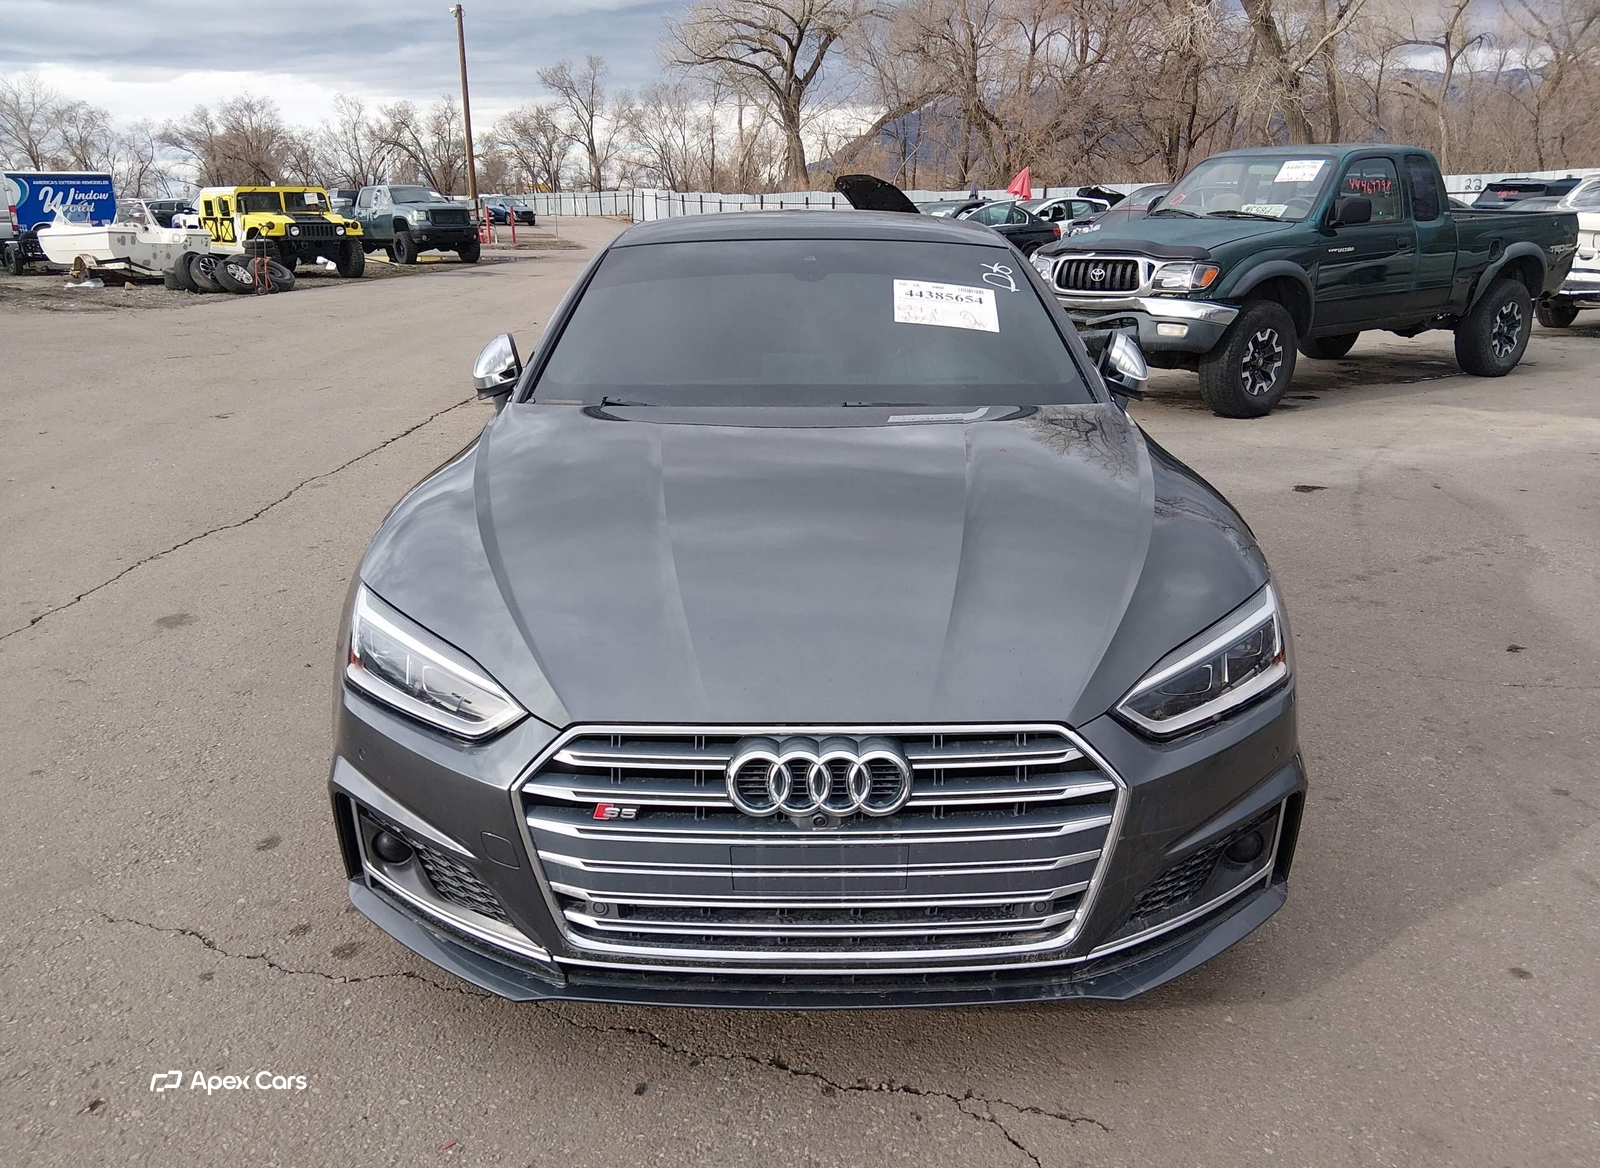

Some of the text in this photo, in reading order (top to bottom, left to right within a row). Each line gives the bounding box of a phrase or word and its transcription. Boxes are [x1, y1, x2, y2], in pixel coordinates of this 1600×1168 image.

[1465, 178, 1482, 191] 22
[39, 186, 109, 213] Window
[905, 289, 984, 304] 44385654
[603, 807, 637, 819] S5
